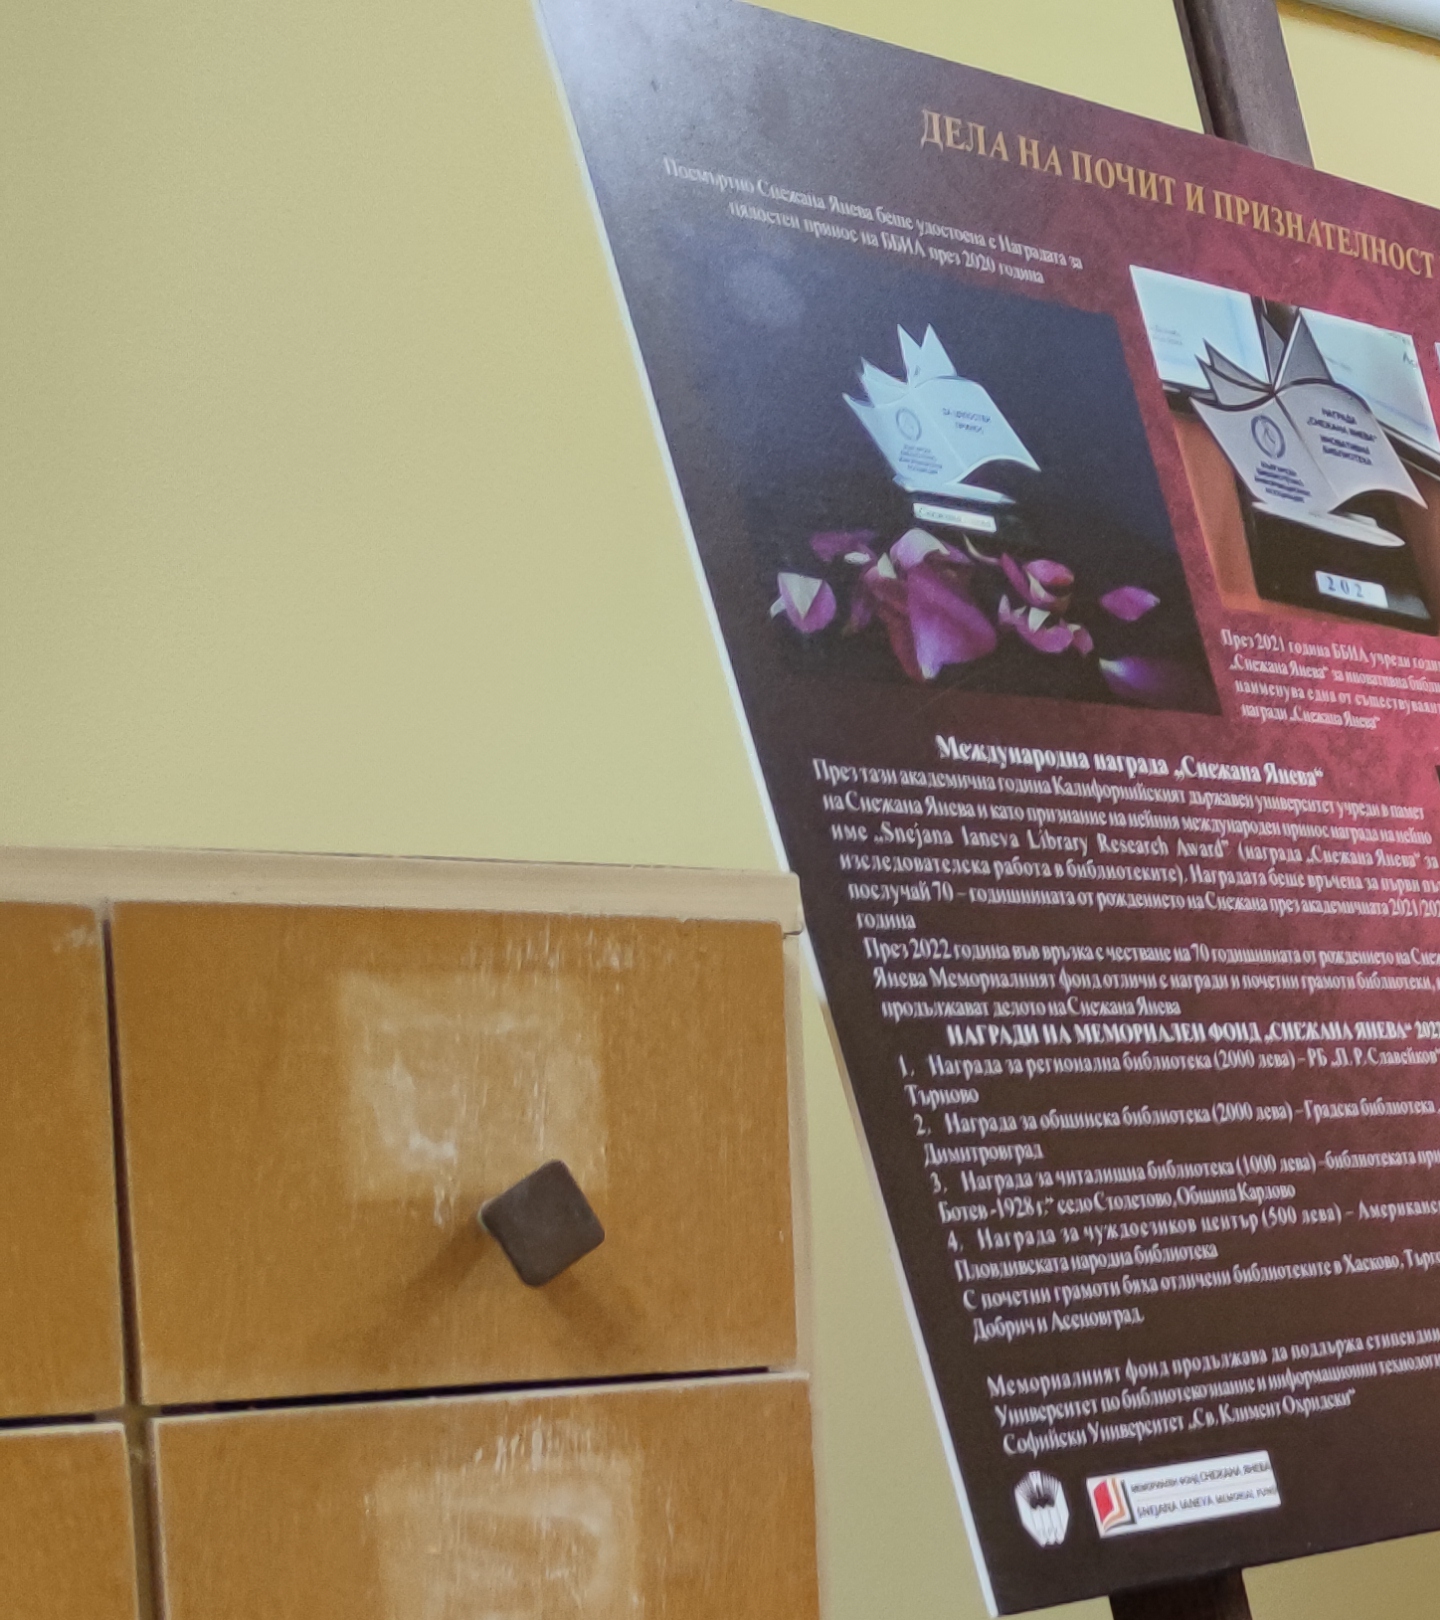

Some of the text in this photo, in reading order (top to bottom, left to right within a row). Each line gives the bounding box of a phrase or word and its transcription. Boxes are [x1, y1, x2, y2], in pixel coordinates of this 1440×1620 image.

[918, 109, 1009, 163] ДЕЛА
[1016, 134, 1063, 177] НА
[1069, 149, 1175, 206] ПОЧИТ
[1183, 179, 1206, 215] И
[1211, 187, 1433, 278] ПРИЗНАТЕЛНОСТ
[935, 735, 1322, 785] Международна награда „Снежана Янева“
[830, 825, 869, 841] име
[960, 826, 1020, 848] Ianeva
[1026, 829, 1090, 856] Library
[1096, 833, 1169, 855] Research
[1235, 840, 1302, 864] (награда
[945, 1025, 1040, 1047] НАГРАДИ
[1074, 1023, 1206, 1043] МЕМОРИАЛЕН
[907, 1087, 980, 1110] Търново
[976, 1230, 1056, 1251] Награда
[1083, 1220, 1197, 1244] чуждоезиков
[1200, 1215, 1261, 1234] център
[1259, 1207, 1298, 1231] (500
[1300, 1203, 1345, 1225] лева)
[986, 1369, 1121, 1397] Мемориалният
[1122, 1361, 1169, 1385] фонд
[1171, 1350, 1268, 1377] продължава
[1290, 1339, 1364, 1359] поддържа
